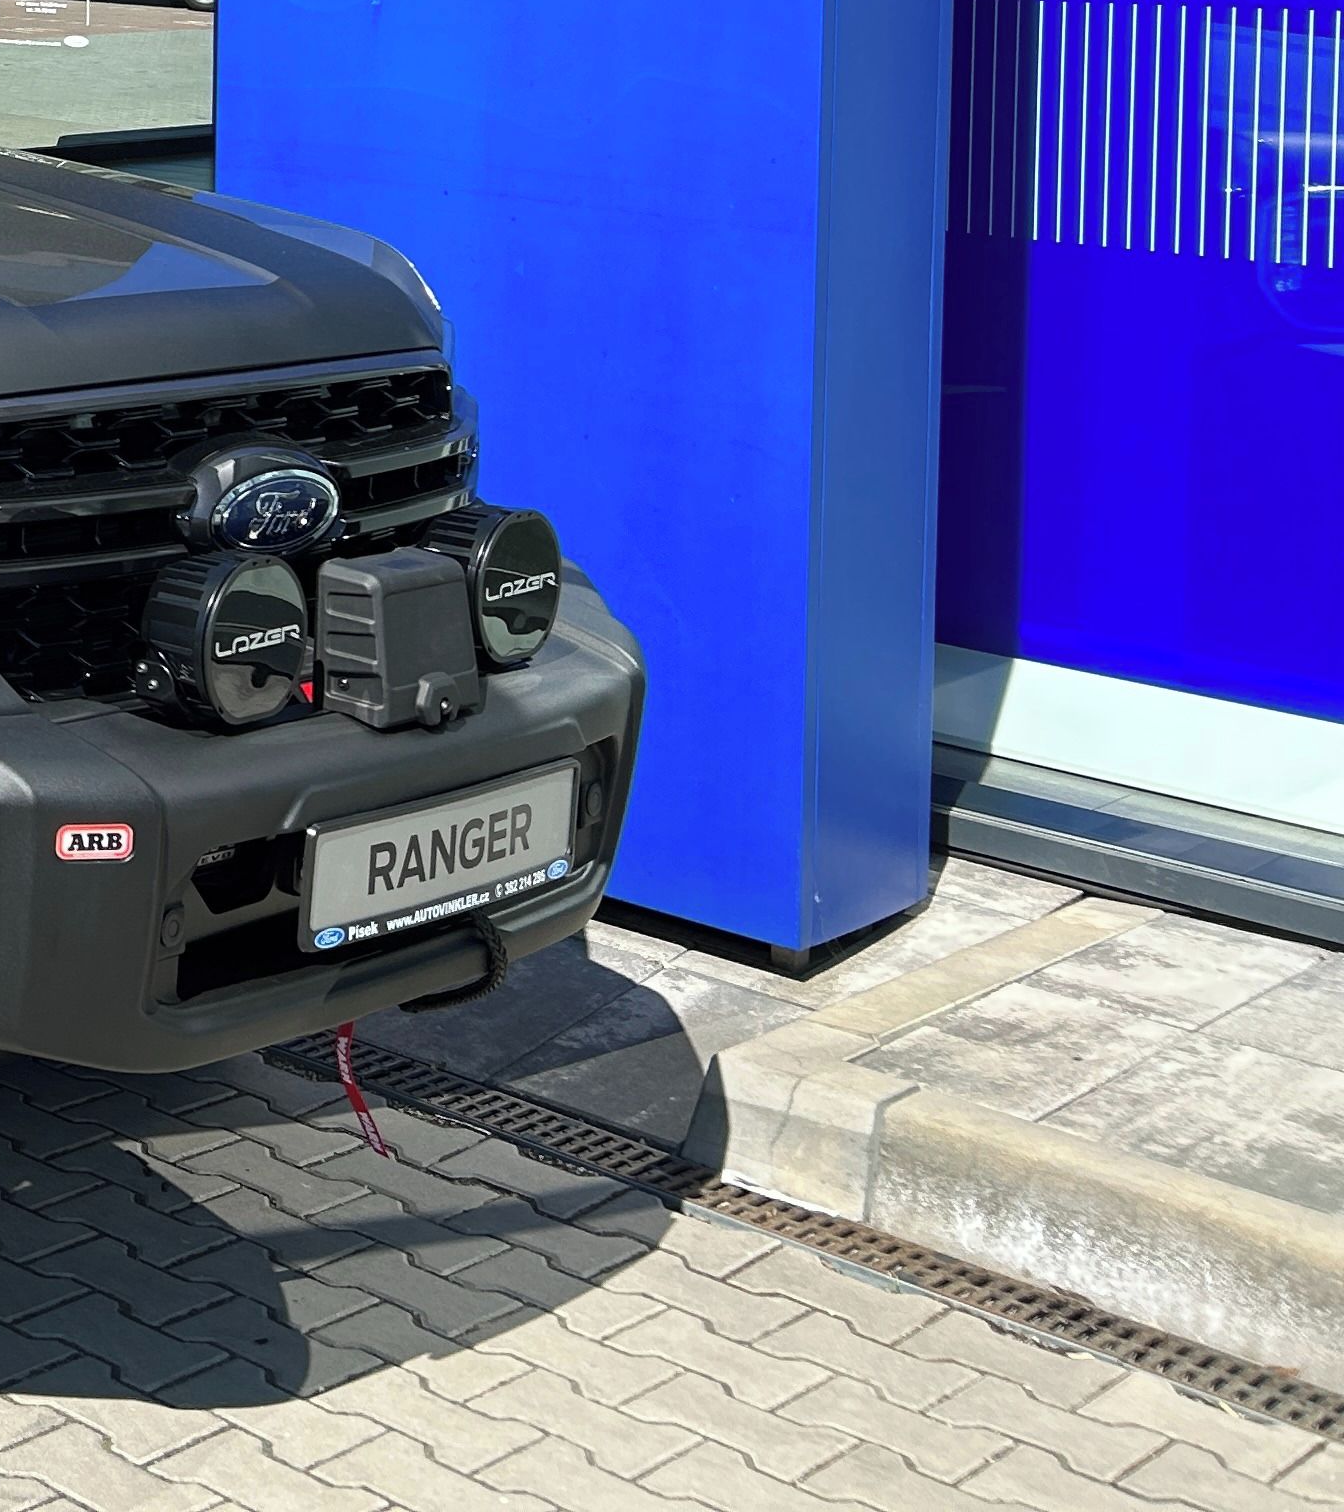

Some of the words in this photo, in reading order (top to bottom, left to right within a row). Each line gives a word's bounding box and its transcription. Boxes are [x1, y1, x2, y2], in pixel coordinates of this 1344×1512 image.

[248, 490, 318, 541] Ford
[485, 570, 558, 604] LAZER
[214, 623, 302, 659] LAZER
[67, 830, 124, 853] ARB
[367, 802, 533, 896] RANGER
